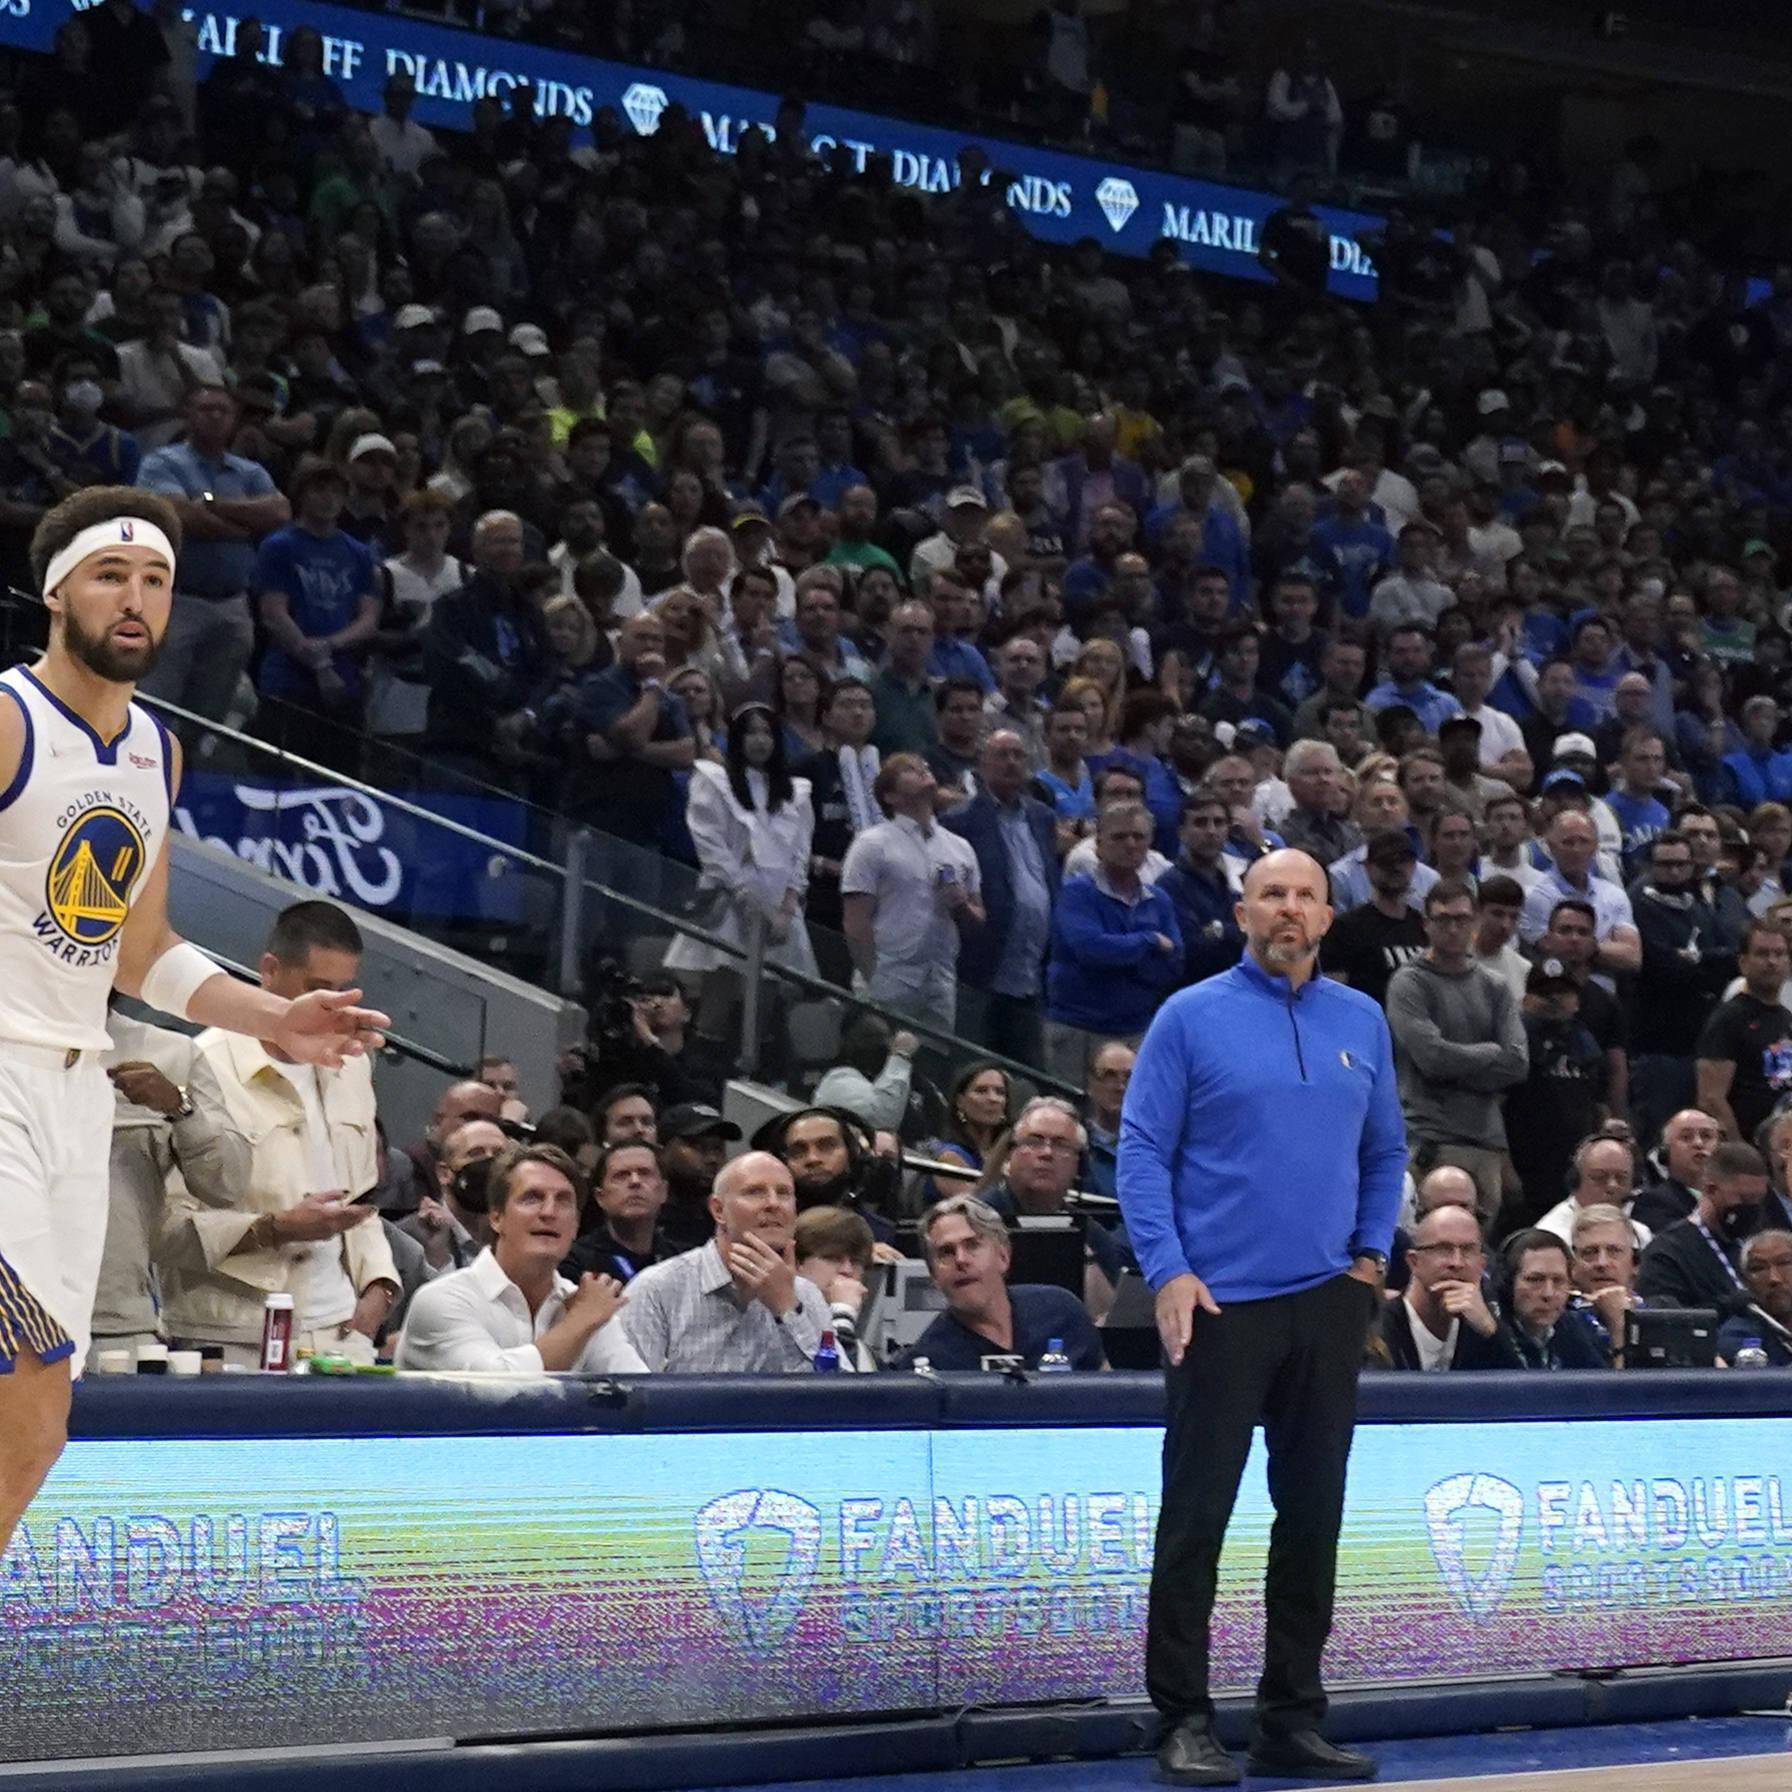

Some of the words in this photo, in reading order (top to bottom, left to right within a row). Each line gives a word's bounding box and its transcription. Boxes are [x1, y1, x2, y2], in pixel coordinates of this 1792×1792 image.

[56, 790, 114, 830] GOLDEN
[118, 796, 153, 842] STATE
[111, 845, 134, 882] 11
